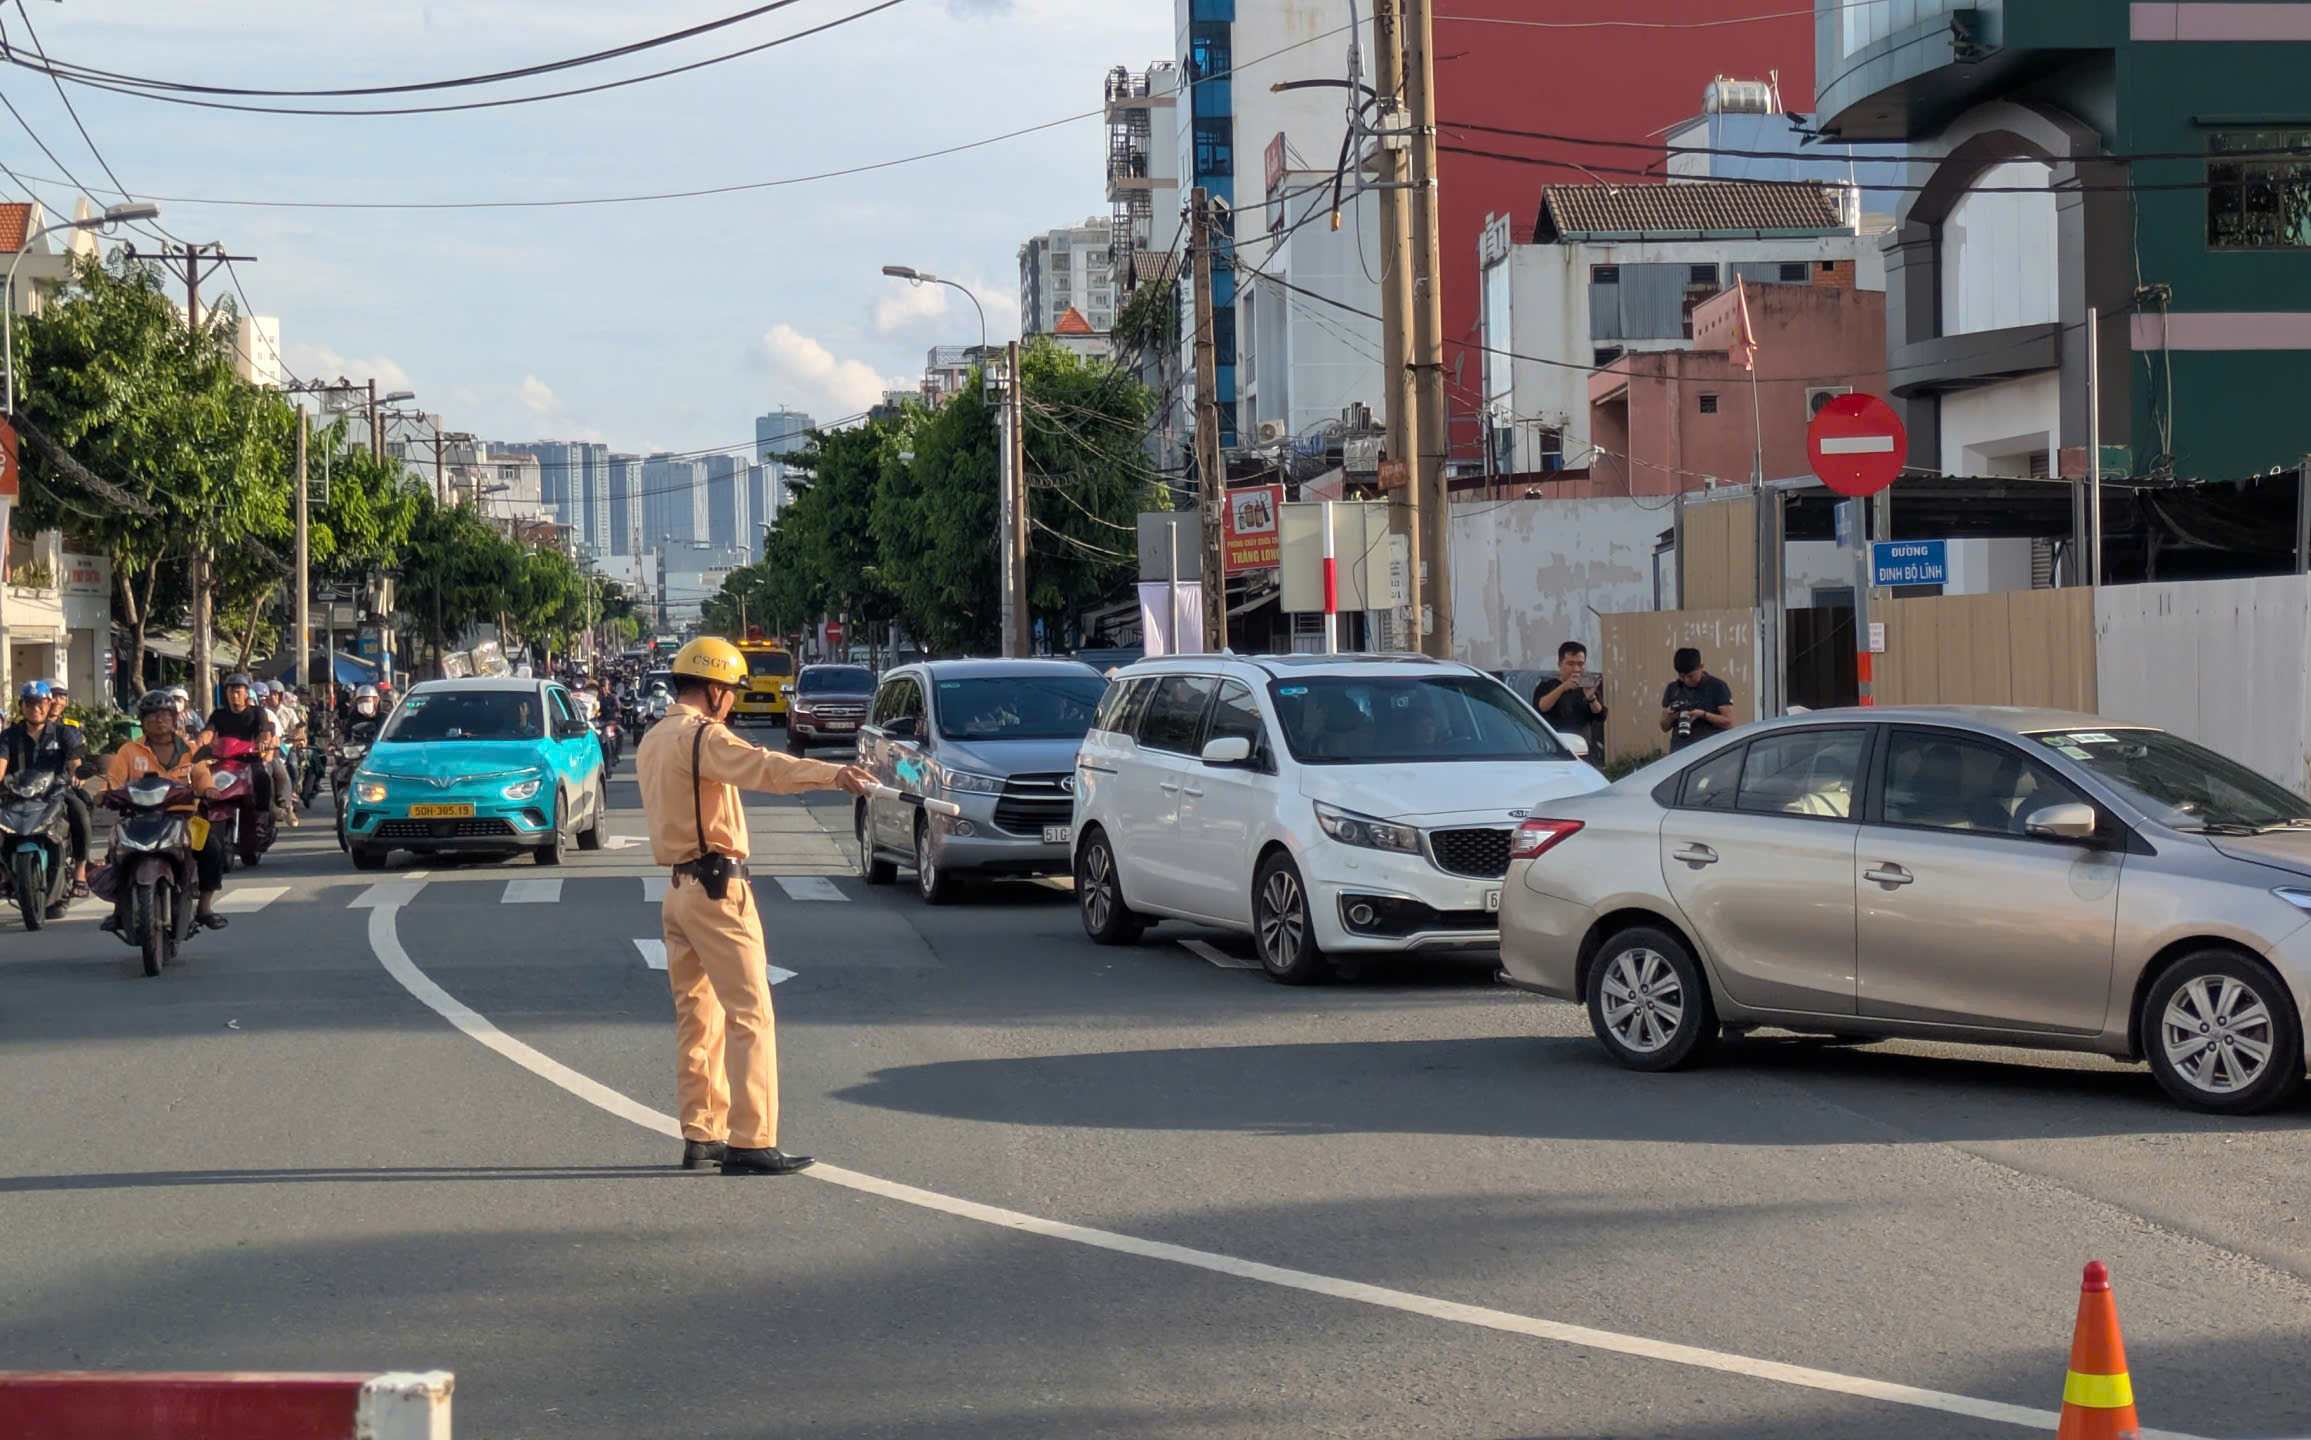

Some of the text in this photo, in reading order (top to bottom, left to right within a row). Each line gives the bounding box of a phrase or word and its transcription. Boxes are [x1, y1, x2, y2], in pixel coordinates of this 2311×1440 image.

[1879, 562, 1943, 583] ĐINH BỘ LĨNH
[692, 655, 729, 671] CSGT
